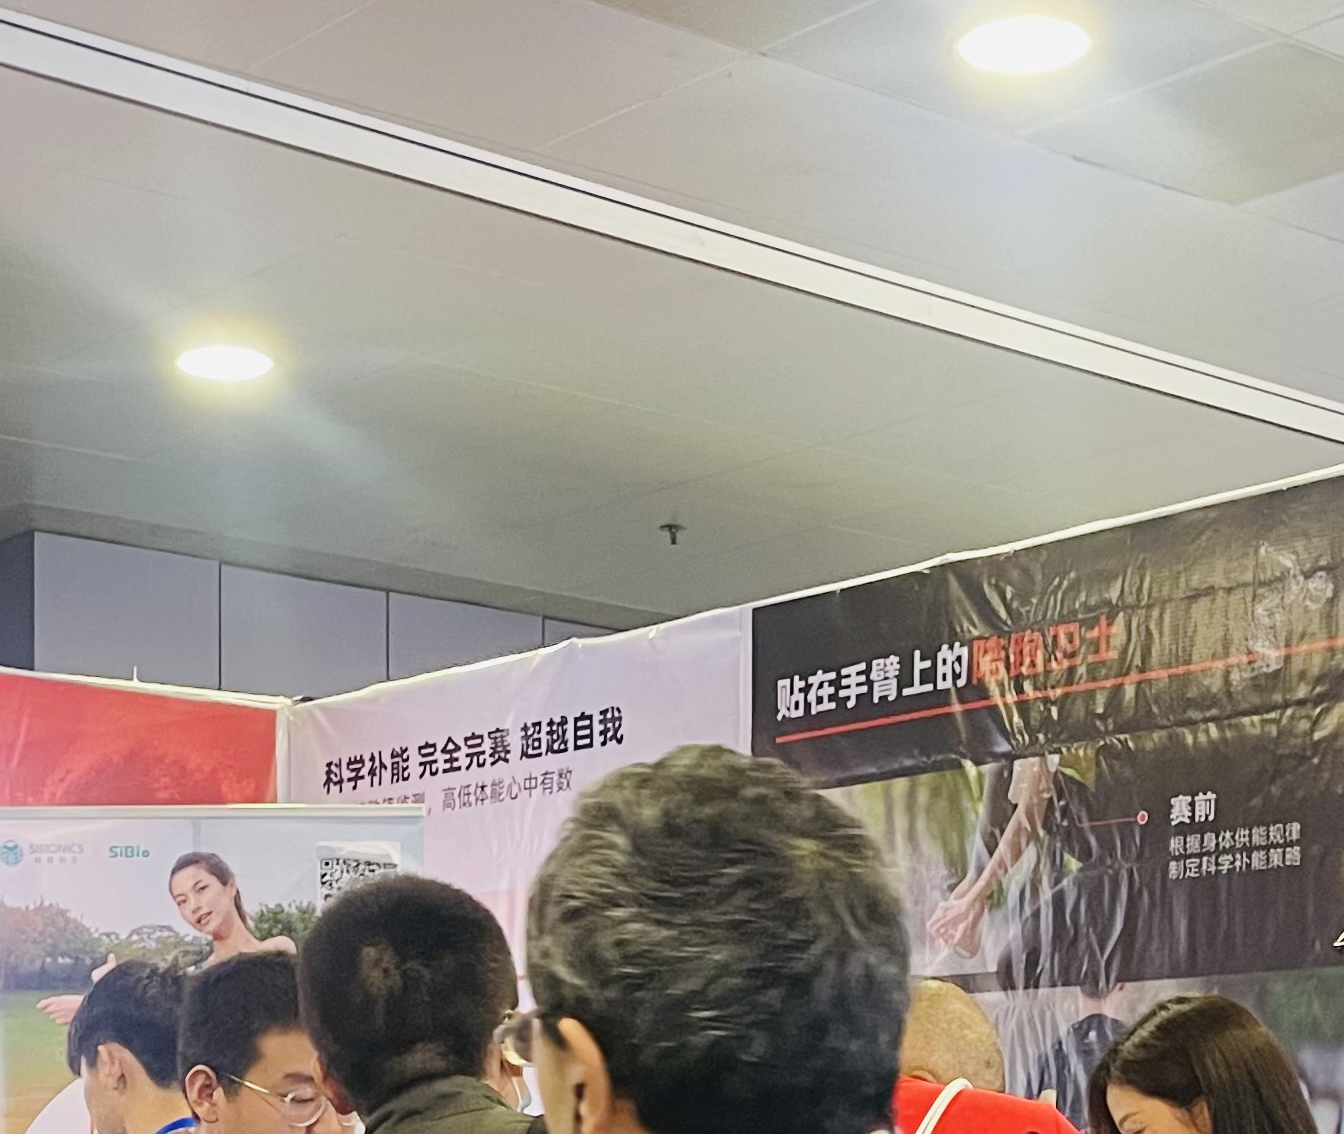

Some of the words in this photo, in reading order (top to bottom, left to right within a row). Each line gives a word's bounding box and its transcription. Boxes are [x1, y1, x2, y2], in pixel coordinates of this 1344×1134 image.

[775, 613, 1122, 721] 贴在手臂上的陪跑卫士
[323, 746, 410, 795] 科学补能
[418, 727, 512, 780] 完全完赛
[519, 706, 625, 760] 超越自我
[1169, 791, 1217, 826] 赛前
[1169, 822, 1301, 856] 根据身体供能规律
[1168, 846, 1301, 880] 制定科学补能策略
